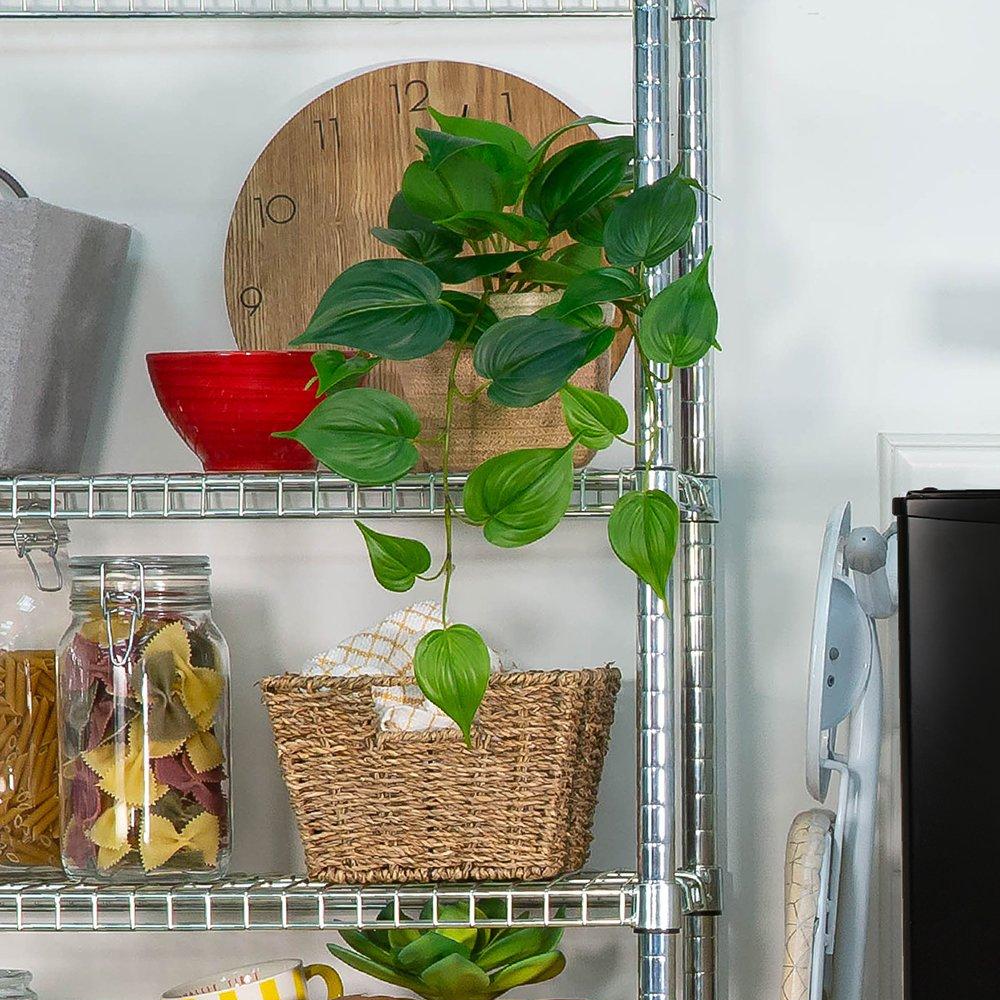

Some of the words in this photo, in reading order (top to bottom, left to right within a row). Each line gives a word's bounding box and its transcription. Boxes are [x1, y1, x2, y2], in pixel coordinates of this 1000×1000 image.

[389, 80, 429, 114] 12
[314, 117, 340, 150] 11
[254, 194, 297, 227] 10
[240, 287, 262, 316] 9
